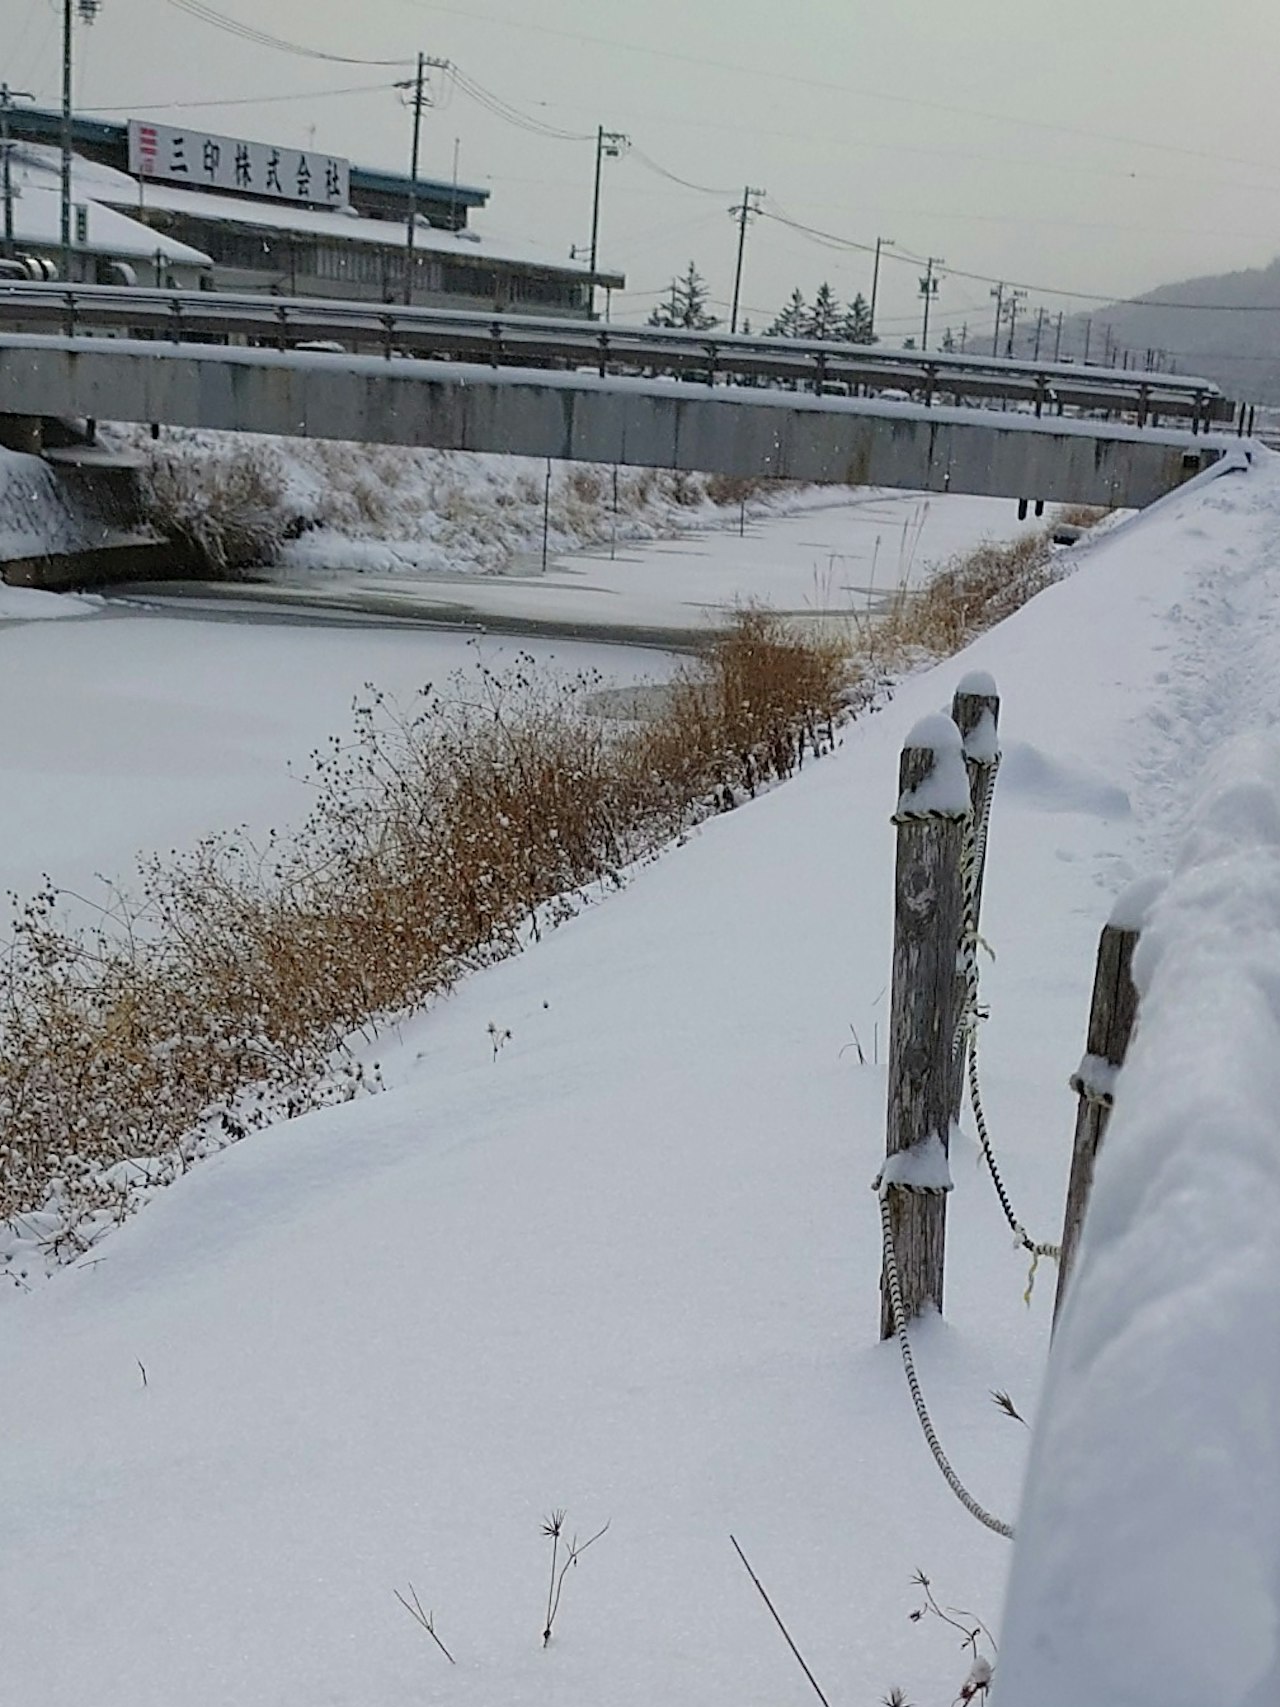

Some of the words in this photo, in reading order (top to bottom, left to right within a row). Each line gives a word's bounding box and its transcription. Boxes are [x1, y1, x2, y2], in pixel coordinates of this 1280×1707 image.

[170, 137, 340, 199] 三印株式会社
